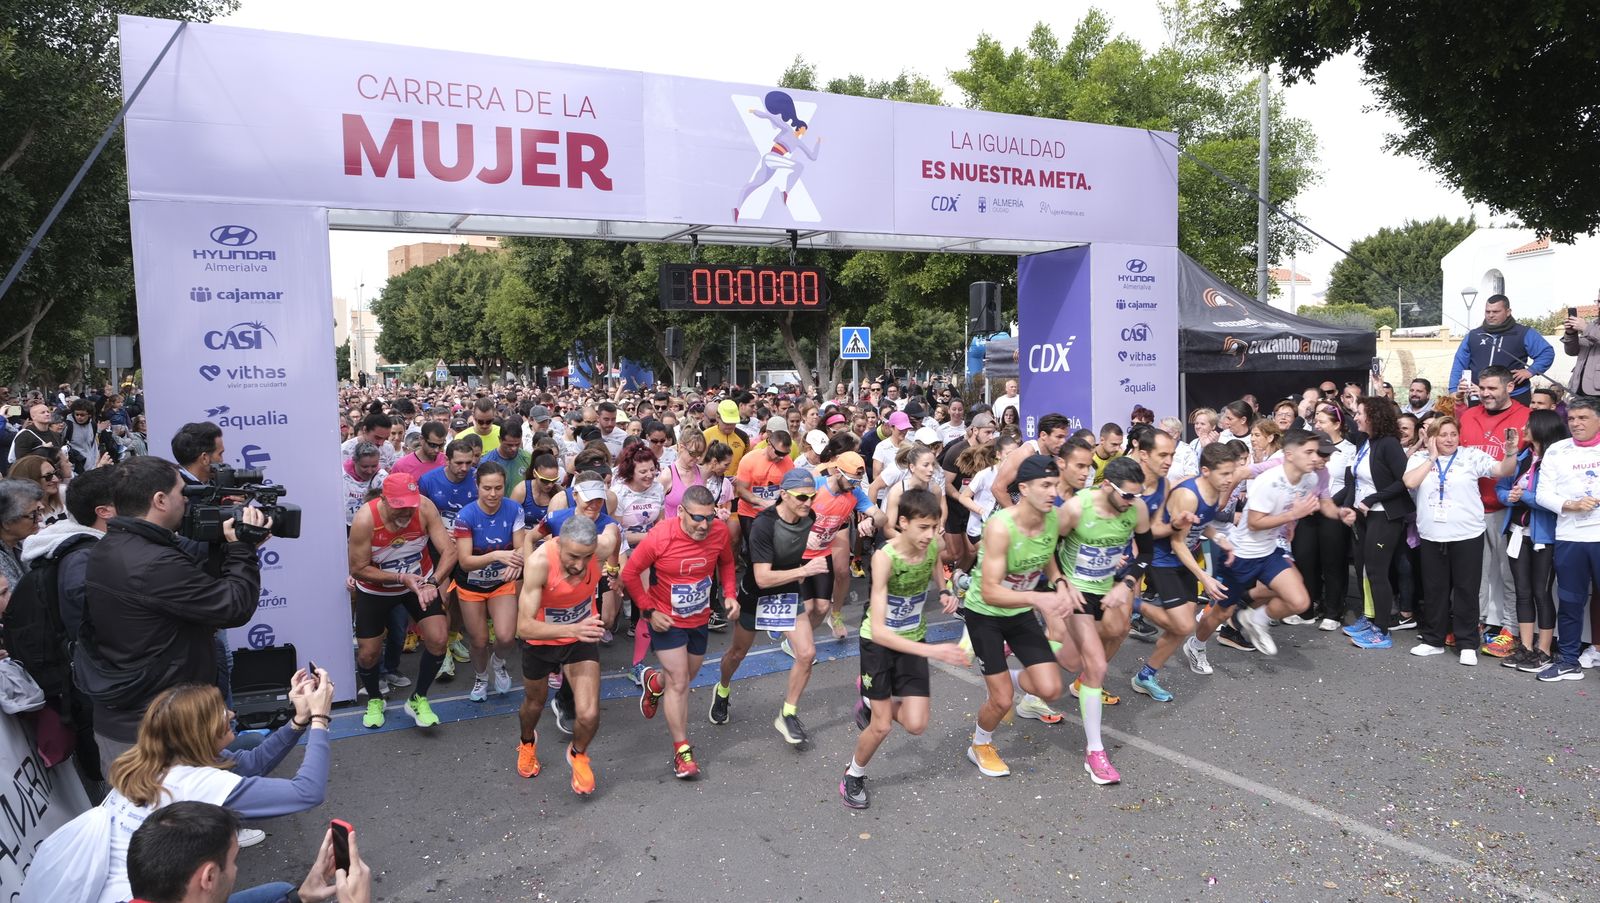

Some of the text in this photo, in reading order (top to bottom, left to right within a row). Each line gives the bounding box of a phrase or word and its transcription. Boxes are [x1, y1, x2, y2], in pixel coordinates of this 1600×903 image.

[357, 74, 596, 119] CARRERA DE LA
[951, 131, 1065, 159] LA IGUALDAD
[342, 113, 613, 191] MUJER
[922, 160, 1092, 191] ES NUESTRA META.
[931, 194, 961, 212] CDX
[992, 197, 1025, 208] ALMERÍA
[193, 250, 277, 261] HYUNDAI
[204, 262, 268, 272] Almerialva
[217, 288, 284, 304] cajamar
[1127, 301, 1158, 310] cajamar
[203, 330, 263, 351] CASI
[1121, 328, 1147, 341] CASI
[1029, 335, 1076, 373] CDX
[1129, 352, 1157, 361] vithas
[226, 366, 287, 380] vithas
[259, 381, 287, 389] cuidarte
[1124, 381, 1156, 395] aqualia
[218, 410, 288, 430] aqualia
[760, 490, 774, 498] 104
[632, 503, 653, 511] MUJER
[478, 570, 499, 578] 190
[762, 604, 792, 615] 2022
